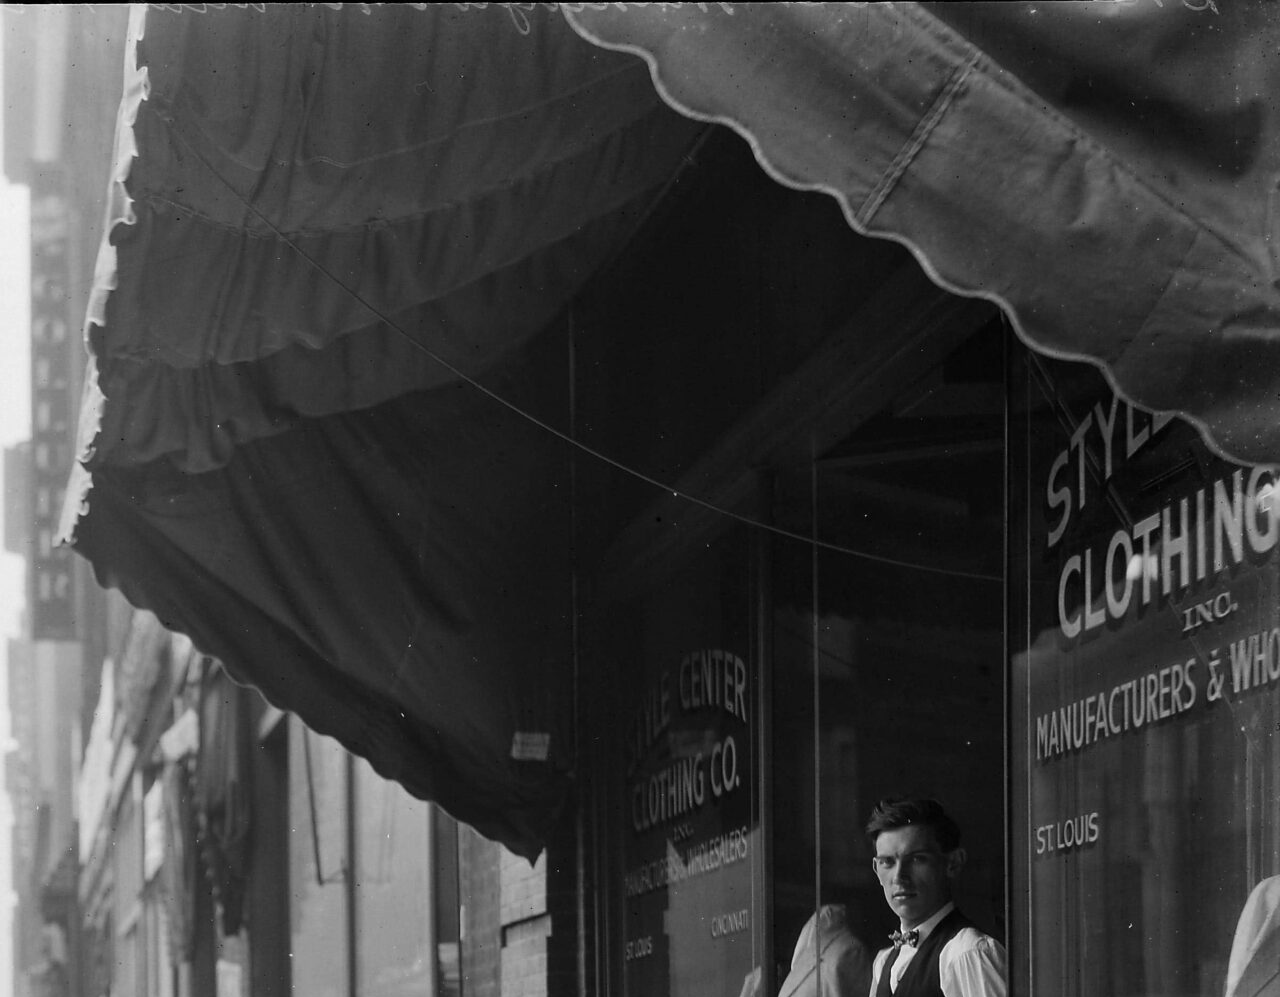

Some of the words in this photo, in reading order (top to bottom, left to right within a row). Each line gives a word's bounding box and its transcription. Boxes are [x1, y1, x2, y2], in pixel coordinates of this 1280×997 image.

[1058, 465, 1280, 638] CLOTHING
[1182, 592, 1238, 632] INC.
[679, 648, 746, 723] CENTER
[1036, 658, 1197, 760] MANUFACTURERS
[1206, 648, 1224, 701] &
[631, 752, 704, 832] CLOTHING
[710, 736, 740, 798] CO.
[686, 825, 748, 877] WHOLESALERS
[1057, 812, 1098, 850] LOUIS
